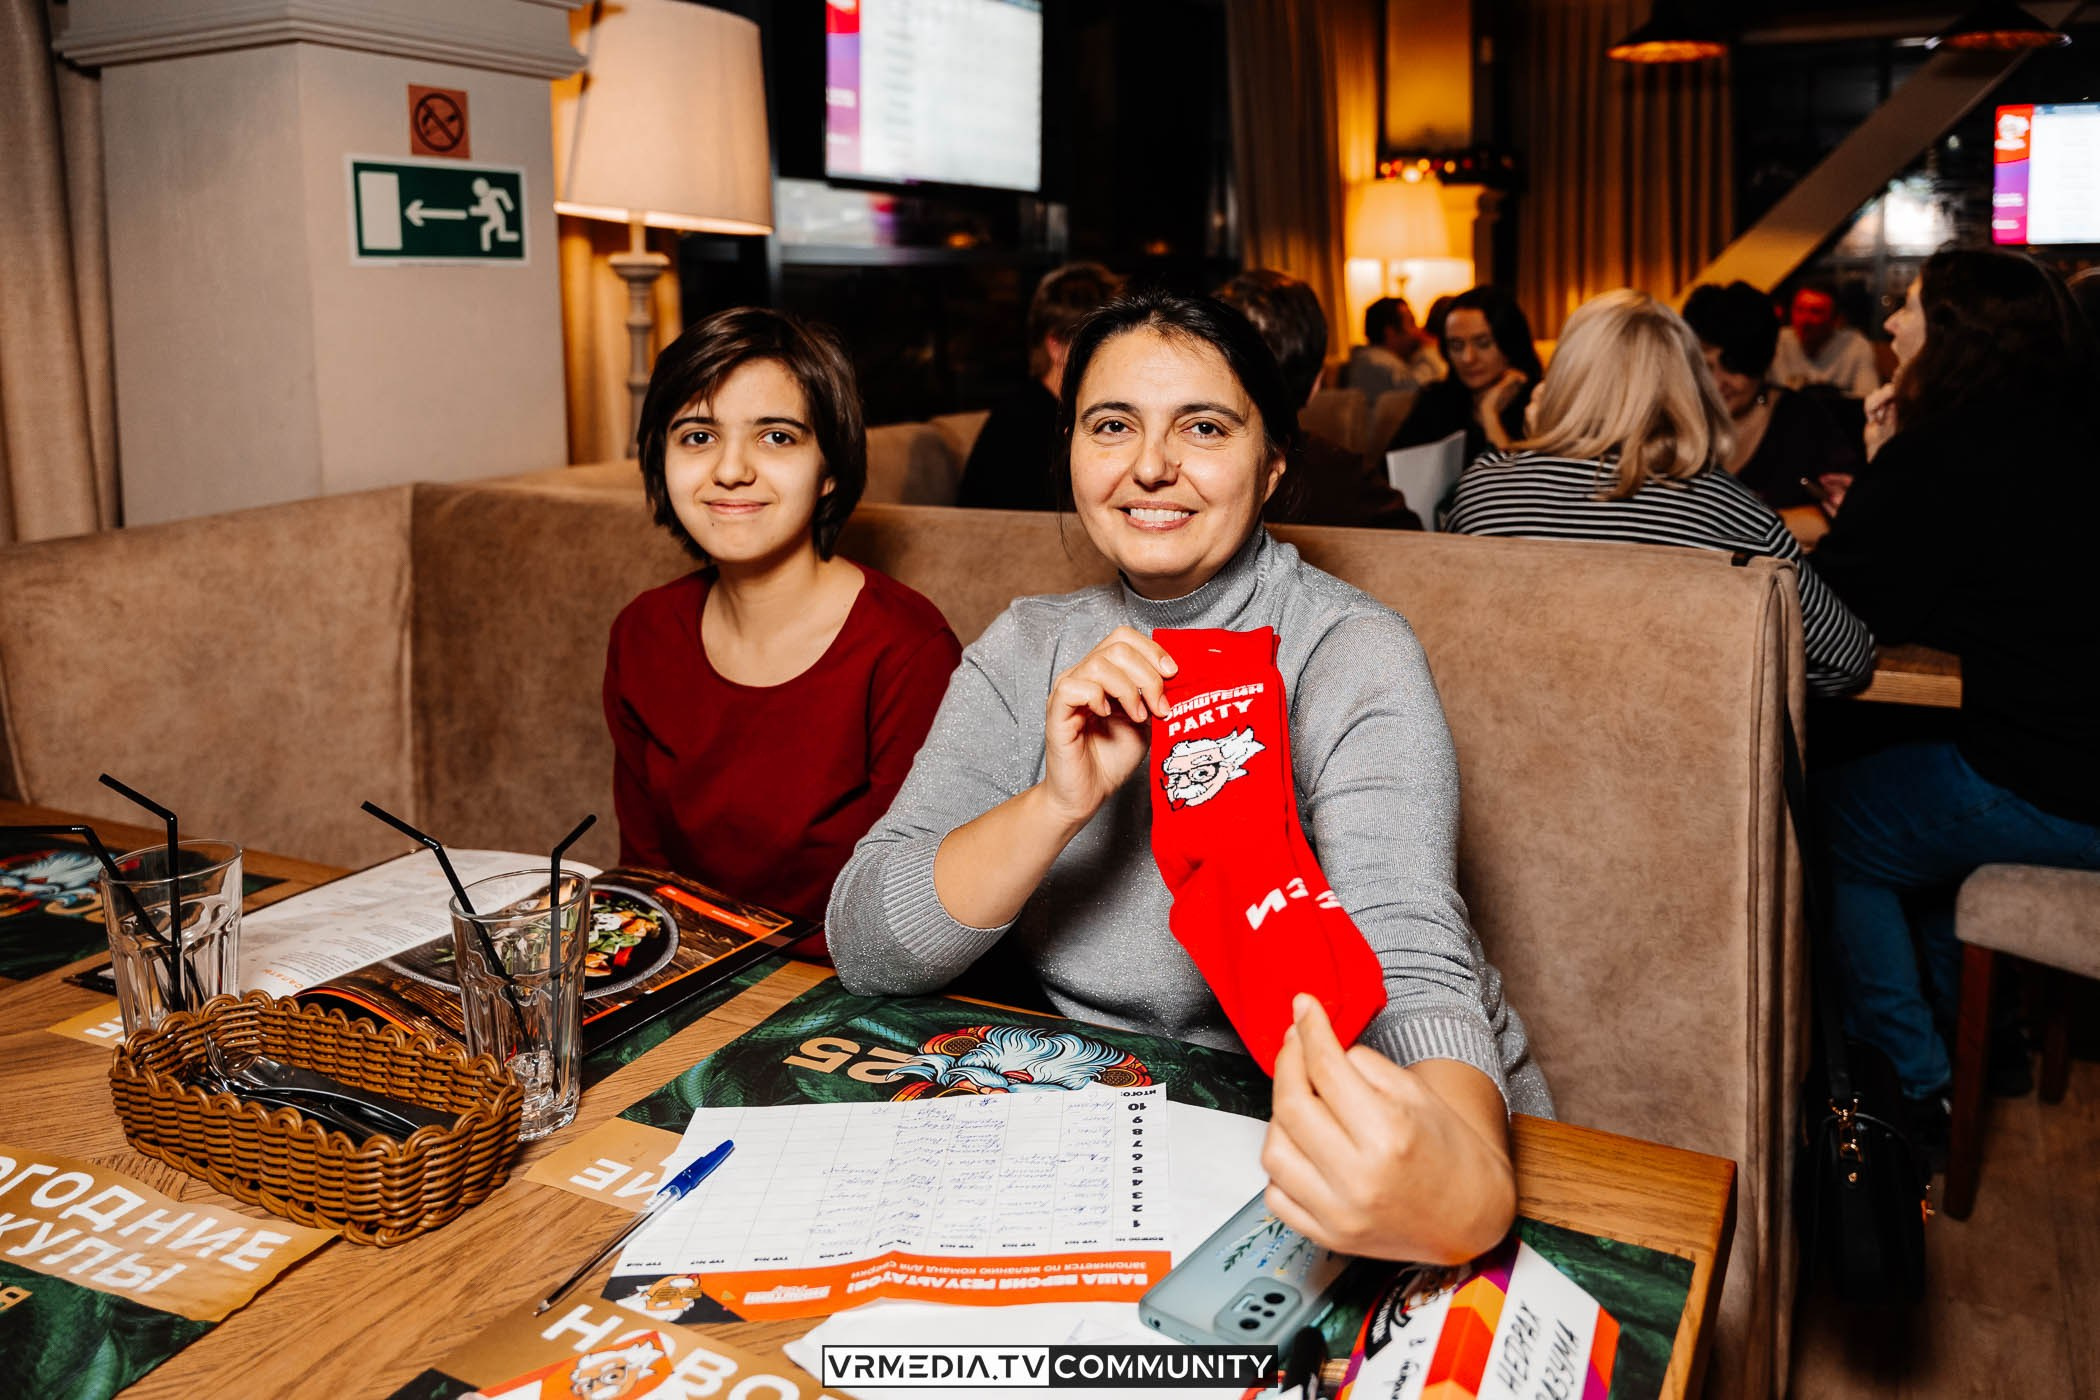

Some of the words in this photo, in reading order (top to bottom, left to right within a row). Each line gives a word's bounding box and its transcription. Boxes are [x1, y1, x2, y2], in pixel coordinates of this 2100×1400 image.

[1168, 698, 1254, 737] PARTY
[1120, 1089, 1157, 1098] ИТОГО:
[1127, 1102, 1147, 1111] 10
[1132, 1115, 1143, 1124] 9
[1132, 1128, 1143, 1136] 8
[1132, 1140, 1143, 1148] 7
[1132, 1153, 1143, 1161] 6
[1132, 1166, 1143, 1174] 5
[1132, 1179, 1143, 1187] 4
[1132, 1191, 1143, 1200] 3
[1132, 1204, 1143, 1213] 2
[0, 1156, 292, 1272] ГОДНИЕ
[1132, 1219, 1142, 1228] 1
[925, 1265, 977, 1275] команд
[979, 1265, 1041, 1275] желанию
[1043, 1264, 1061, 1273] по
[1064, 1261, 1147, 1272] заполняется
[846, 1271, 997, 1294] РЕЗУЛЬТАТОВ!
[998, 1274, 1079, 1290] ВЕРСИЯ
[1081, 1273, 1148, 1286] ВАША
